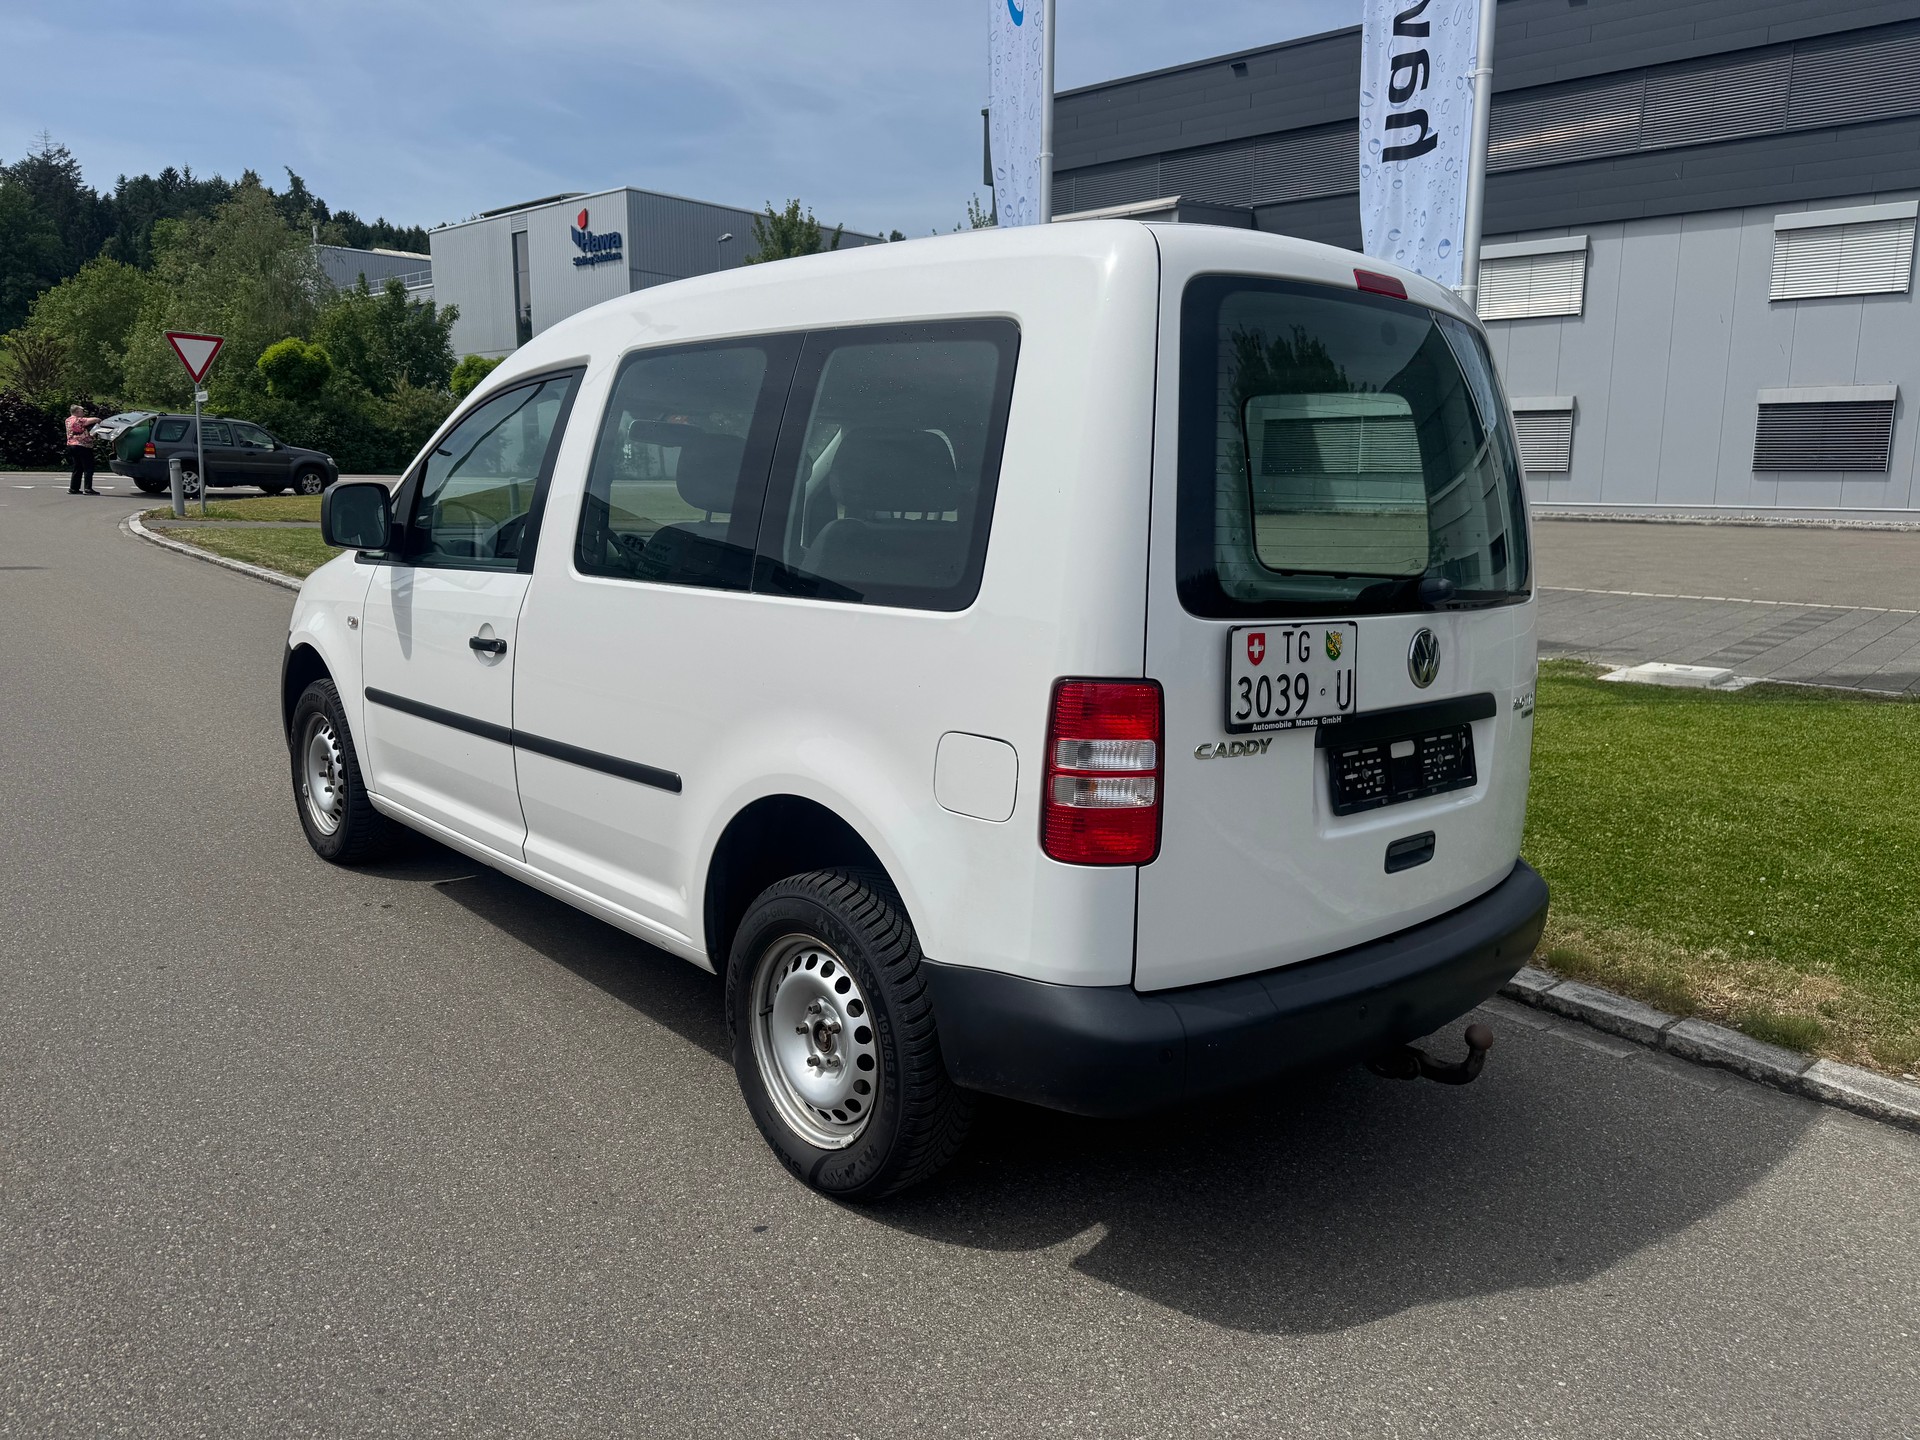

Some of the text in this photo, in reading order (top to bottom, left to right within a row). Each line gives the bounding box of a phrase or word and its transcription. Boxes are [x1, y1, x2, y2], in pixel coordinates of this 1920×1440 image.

[580, 230, 622, 253] Hawa
[1283, 631, 1310, 663] TG
[1235, 669, 1352, 720] 3039 U
[1252, 716, 1342, 731] Automobile Manda GmbH
[1194, 738, 1273, 760] CADDY
